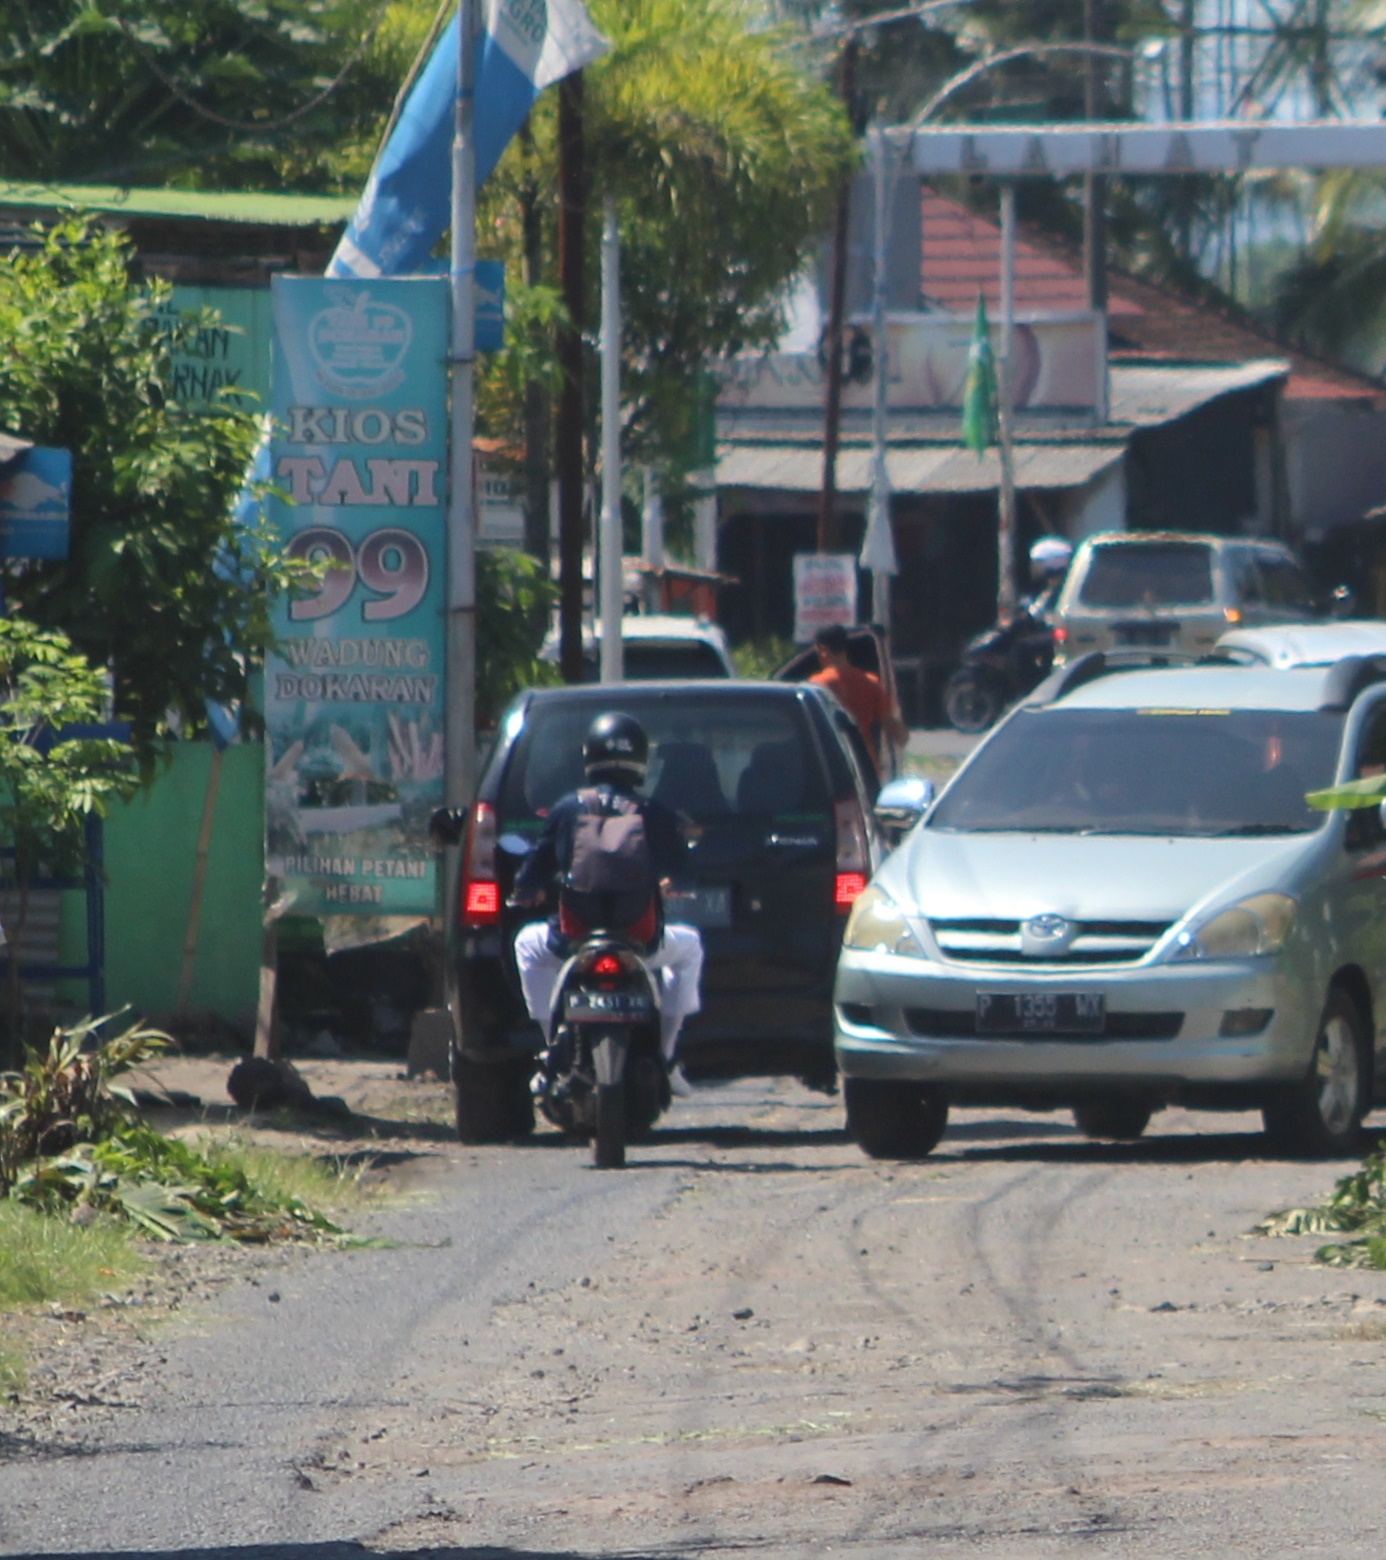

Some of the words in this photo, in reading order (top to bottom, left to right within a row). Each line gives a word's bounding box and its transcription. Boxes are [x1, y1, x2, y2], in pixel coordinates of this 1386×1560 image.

[171, 363, 243, 406] RNAK
[288, 407, 428, 445] KIOS
[277, 456, 440, 506] TANI
[285, 527, 429, 623] 99
[287, 639, 430, 669] WADUNG
[275, 673, 438, 704] DOKARAN
[284, 855, 356, 877] PILIHAN
[362, 859, 427, 878] PETANI
[325, 883, 384, 904] HEBAT
[981, 994, 992, 1019] P
